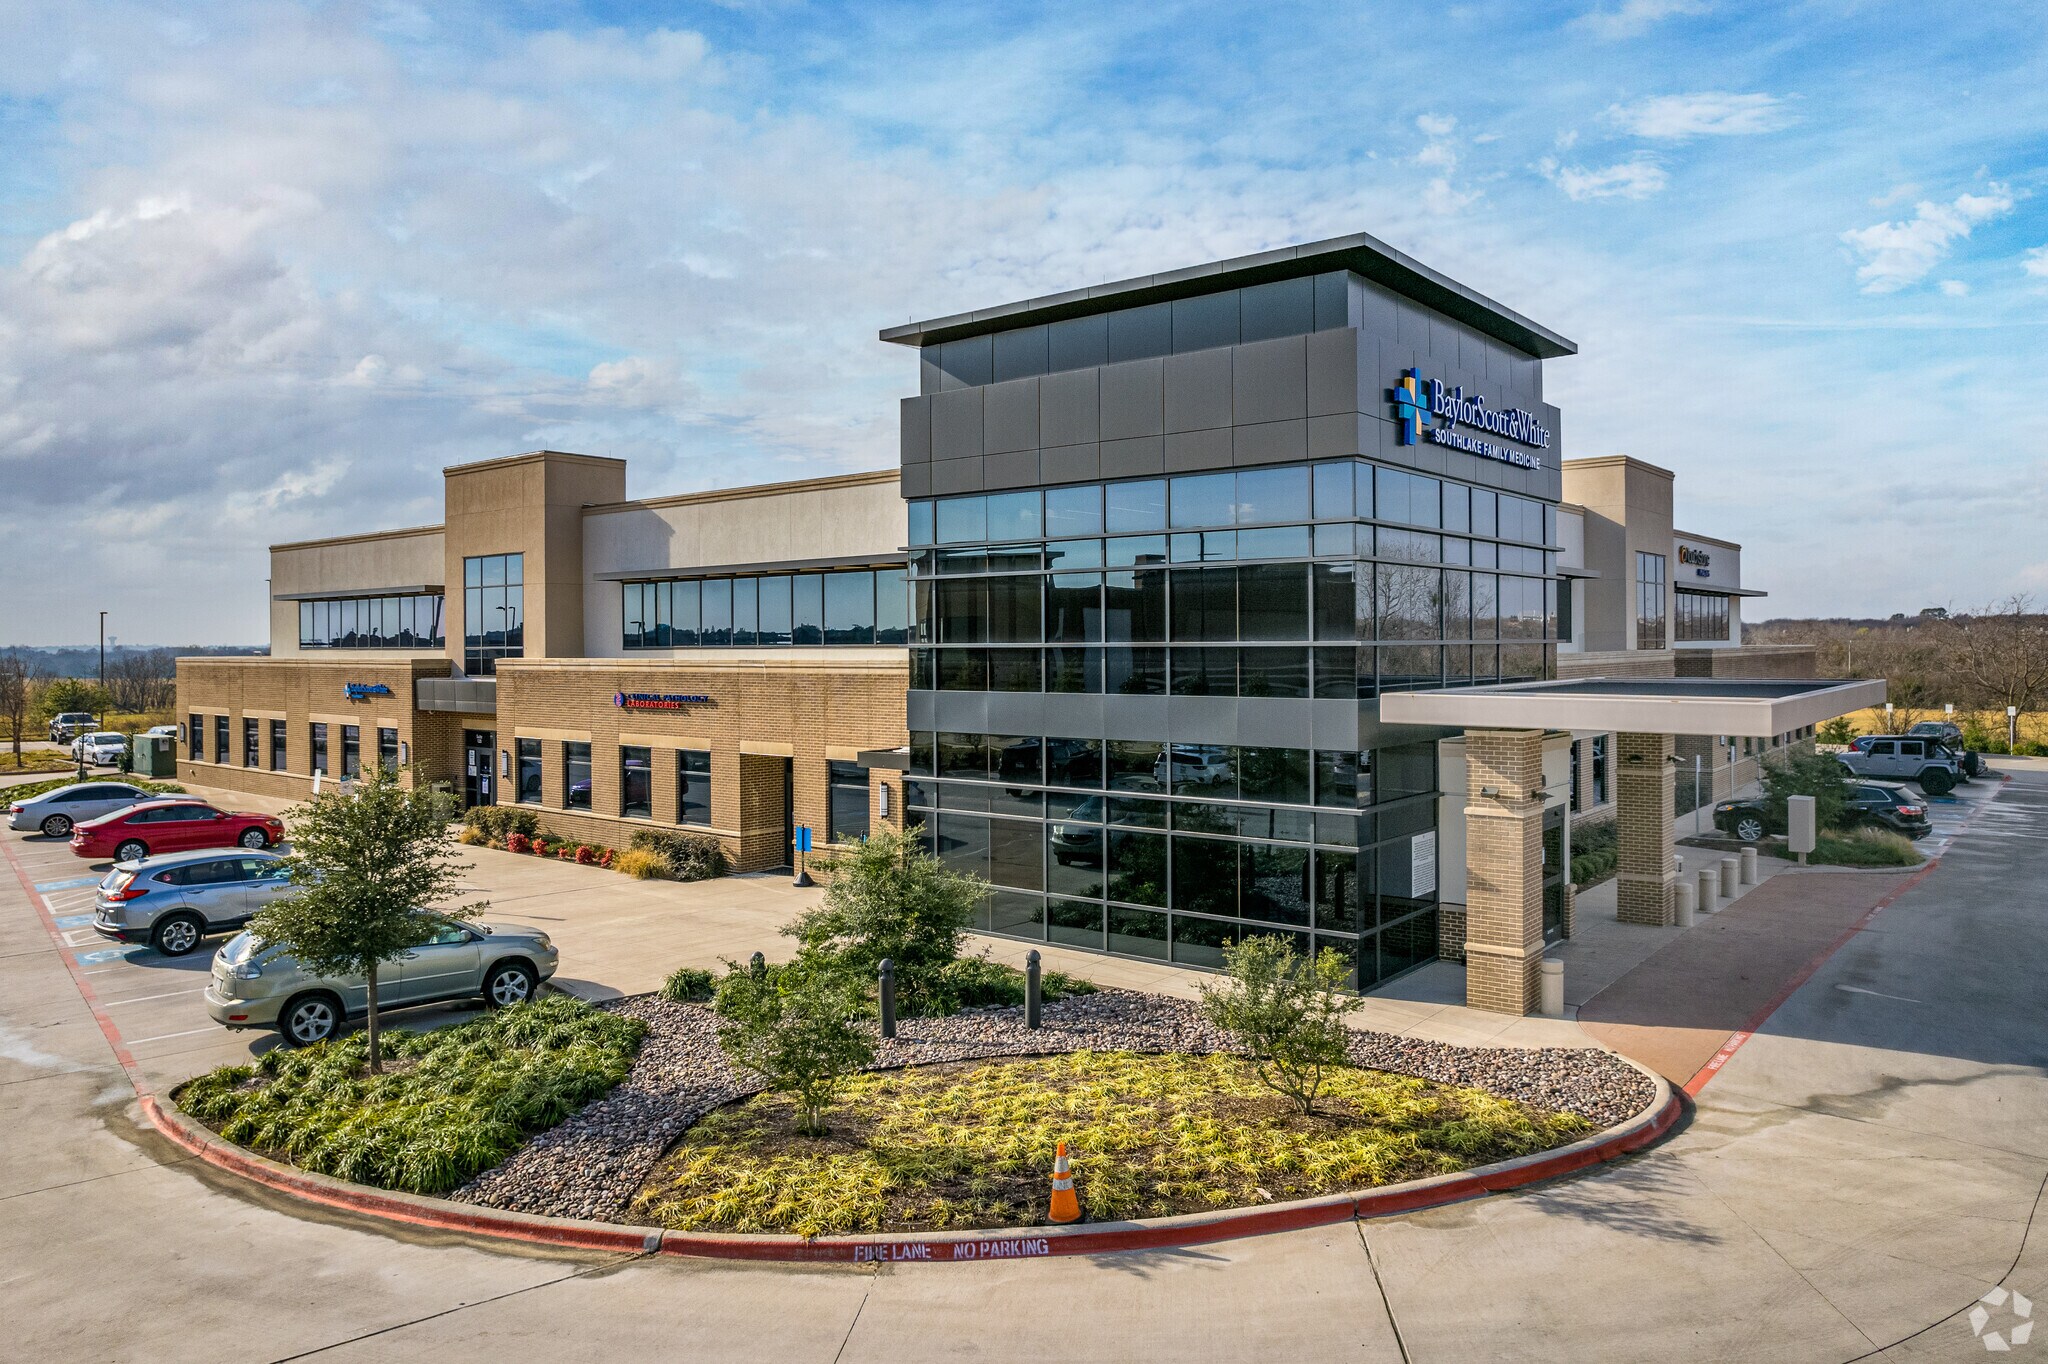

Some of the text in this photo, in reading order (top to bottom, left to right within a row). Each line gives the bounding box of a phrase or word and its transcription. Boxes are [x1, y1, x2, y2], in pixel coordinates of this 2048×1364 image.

[1432, 378, 1550, 449] BaylorScott&White
[1434, 428, 1541, 470] SOUTHLAKE FAMILY MEDICINE
[627, 700, 680, 709] LABORATORIES
[854, 1238, 1049, 1262] FIRE LANE NO PARKING
